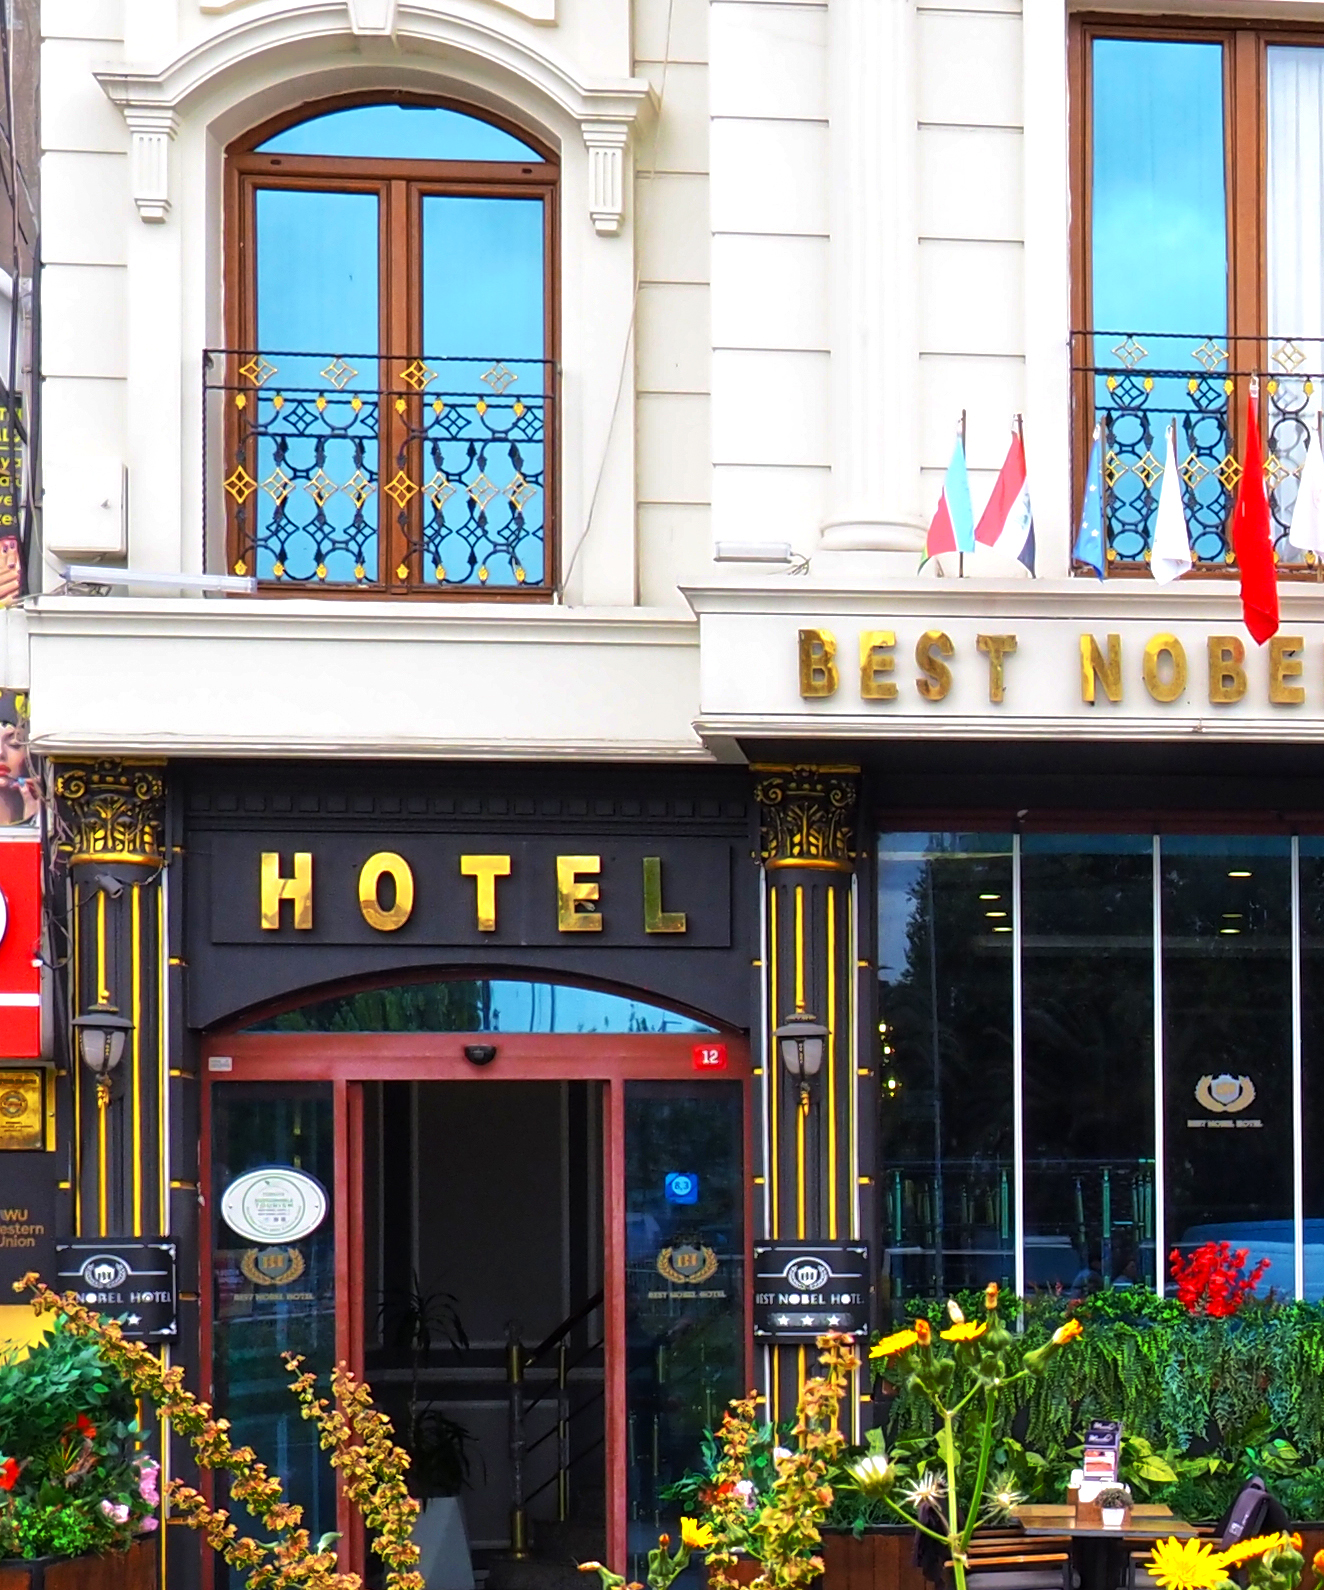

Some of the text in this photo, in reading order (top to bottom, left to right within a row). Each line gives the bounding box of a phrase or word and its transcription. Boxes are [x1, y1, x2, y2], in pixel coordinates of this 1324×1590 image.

[798, 627, 1018, 705] BEST
[258, 851, 688, 934] HOTEL
[702, 1049, 719, 1065] 12
[0, 1223, 45, 1236] estern
[778, 1293, 826, 1306] NOBEL
